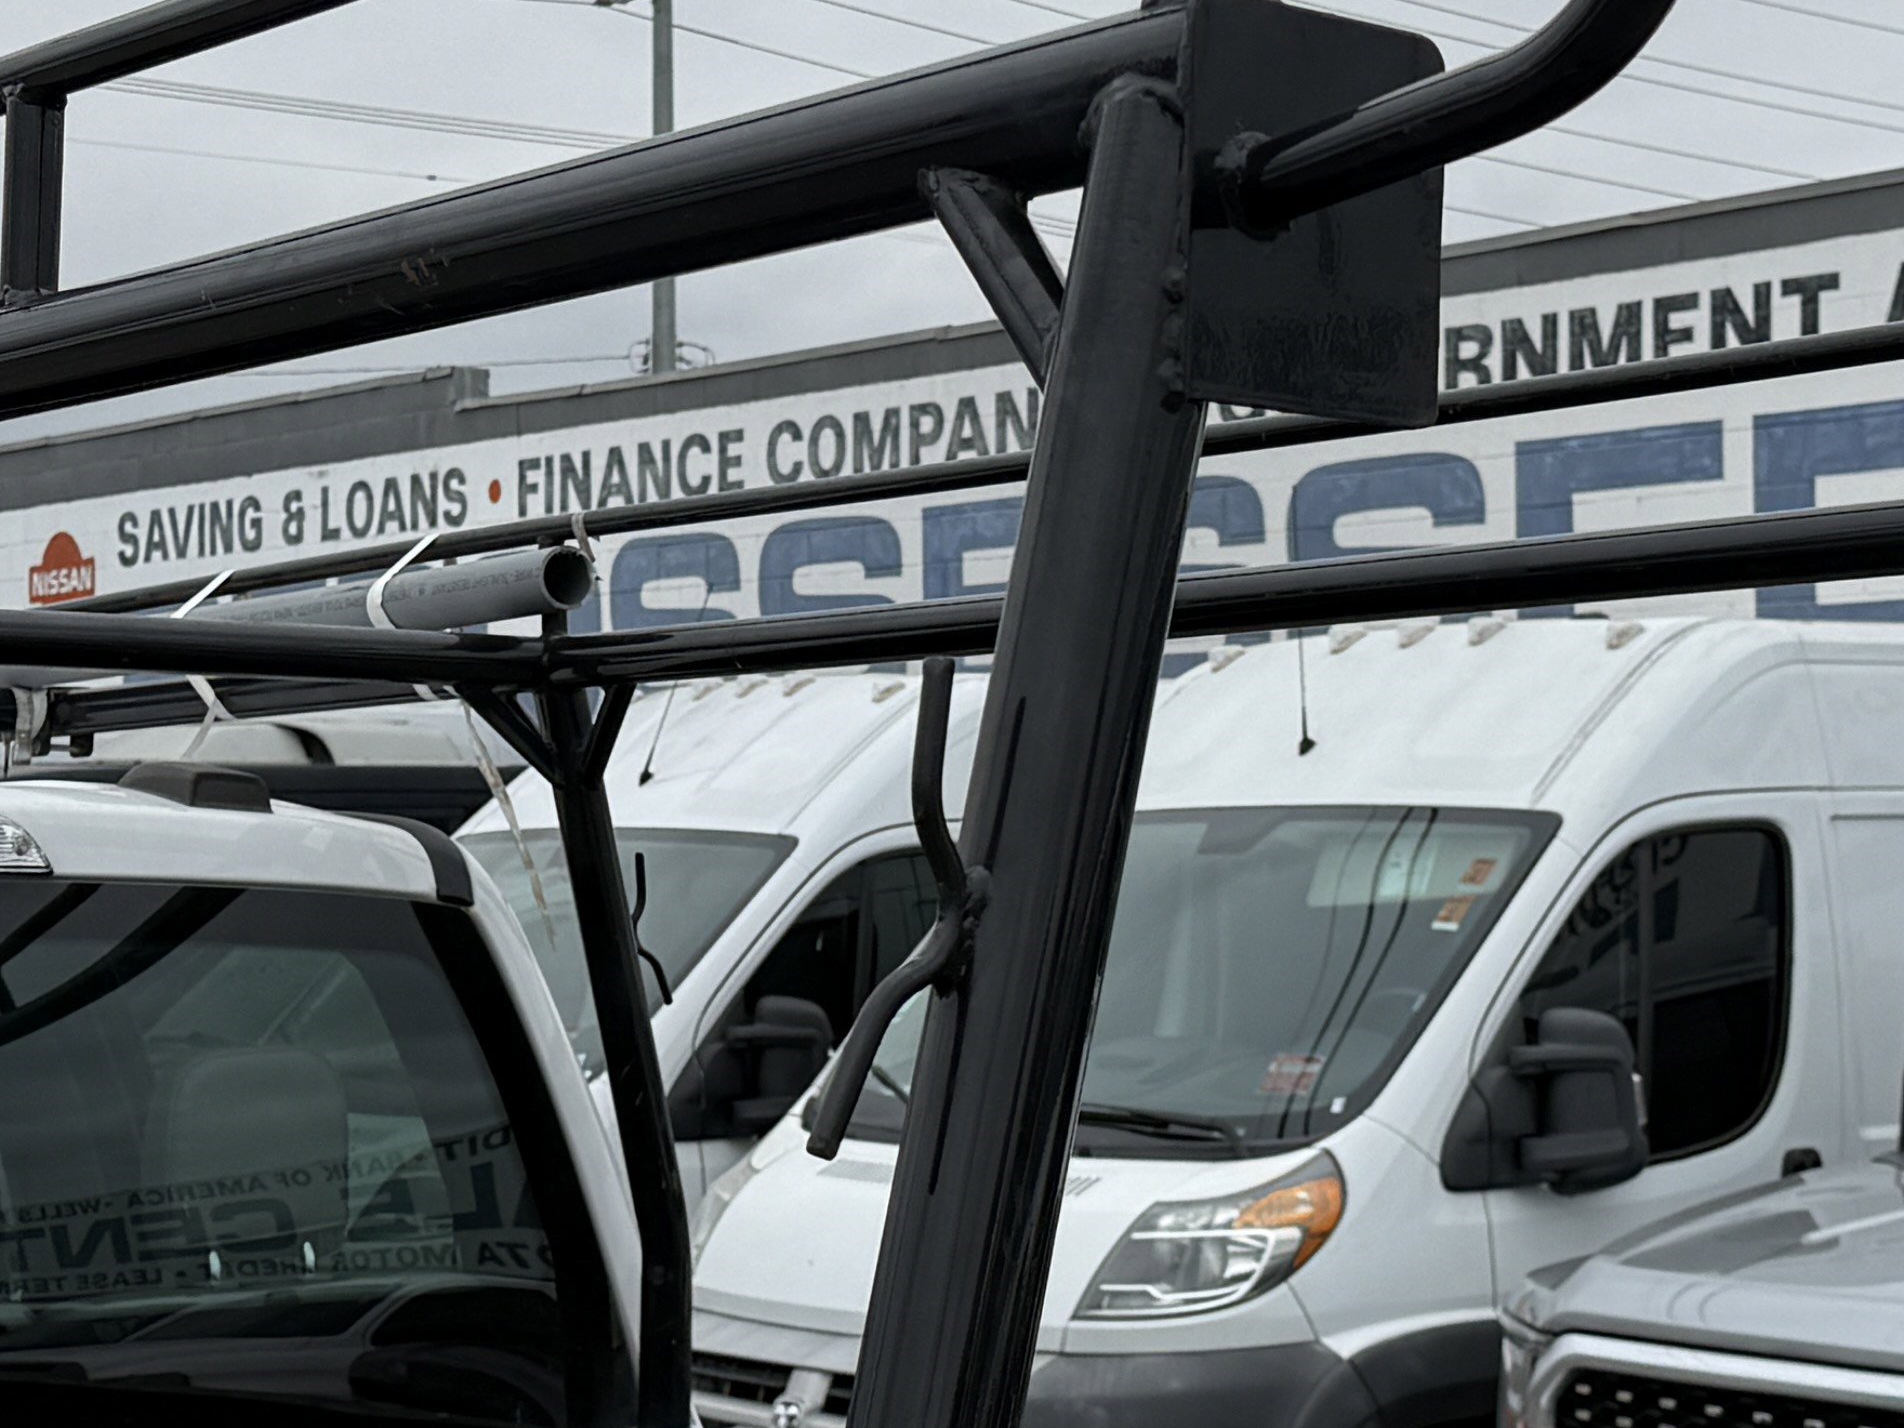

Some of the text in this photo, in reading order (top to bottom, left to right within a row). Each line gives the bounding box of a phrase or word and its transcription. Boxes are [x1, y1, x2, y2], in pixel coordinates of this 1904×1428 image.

[116, 466, 467, 567] SAVING & LOANS
[518, 429, 745, 518] FINANCE
[31, 564, 93, 598] NISSAN
